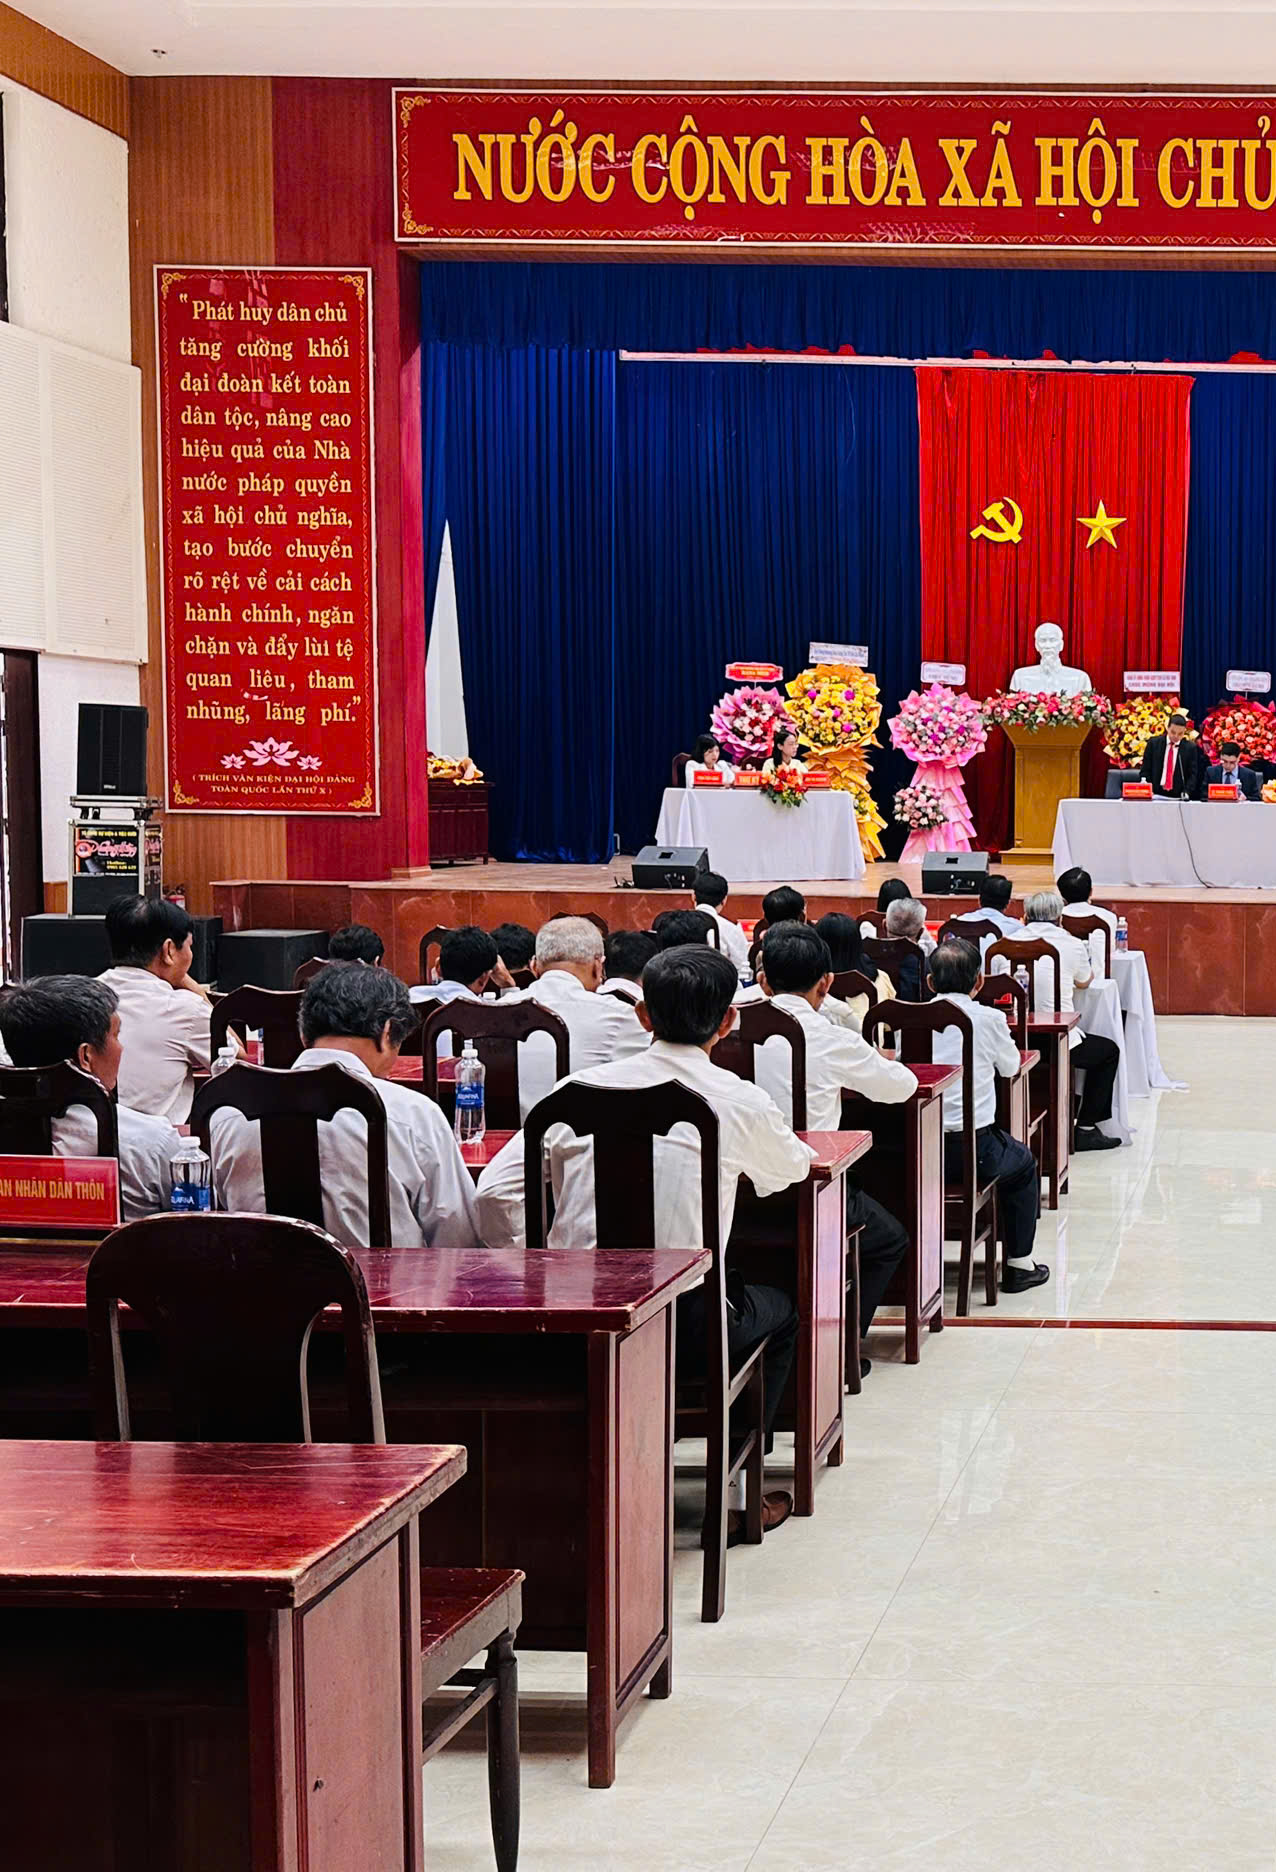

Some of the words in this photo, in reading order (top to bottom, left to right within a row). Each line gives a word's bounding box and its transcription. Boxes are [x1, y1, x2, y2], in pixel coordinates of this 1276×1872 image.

[452, 111, 615, 203] NƯỚC
[631, 115, 791, 220] CỘNG
[805, 117, 927, 206] HÒA
[938, 121, 1023, 207] XÃ
[1034, 117, 1140, 225] HỘI
[239, 301, 274, 326] huy
[276, 301, 311, 321] dân
[314, 301, 349, 322] chủ
[179, 338, 223, 361] tăng
[237, 339, 293, 361] cường
[307, 336, 350, 358] khối
[180, 371, 210, 396] đại
[217, 372, 264, 393] đoàn
[270, 374, 302, 393] kết
[308, 375, 350, 394] toàn
[180, 405, 216, 425] dân
[224, 407, 260, 431] tộc,
[266, 407, 313, 432] nâng
[319, 413, 352, 427] cao
[181, 439, 224, 458] hiệu
[231, 444, 265, 462] quả
[272, 439, 305, 460] của
[313, 439, 351, 460] Nhà
[183, 473, 227, 491] nước
[238, 471, 285, 497] pháp
[295, 471, 352, 497] quyền
[183, 505, 204, 524] xã
[215, 504, 244, 529] hội
[254, 503, 287, 525] chủ
[297, 505, 353, 530] nghĩa,
[183, 539, 214, 559] tạo
[228, 537, 272, 558] bước
[285, 535, 353, 562] chuyển
[183, 571, 204, 589] rõ
[211, 571, 240, 593] rệt
[247, 571, 267, 591] về
[275, 569, 303, 591] cải
[310, 571, 352, 592] cách
[185, 602, 232, 622] hành
[308, 607, 354, 629] ngăn
[184, 633, 231, 657] chặn
[235, 635, 259, 655] và
[263, 632, 298, 661] đẩy
[334, 637, 354, 662] tệ
[186, 672, 232, 691] quan
[307, 670, 355, 689] tham
[186, 699, 249, 725] nhũng,
[320, 695, 361, 726] phí.”
[15, 1176, 46, 1198] NHÂN
[49, 1177, 73, 1199] DÂN
[75, 1178, 105, 1201] THÔN
